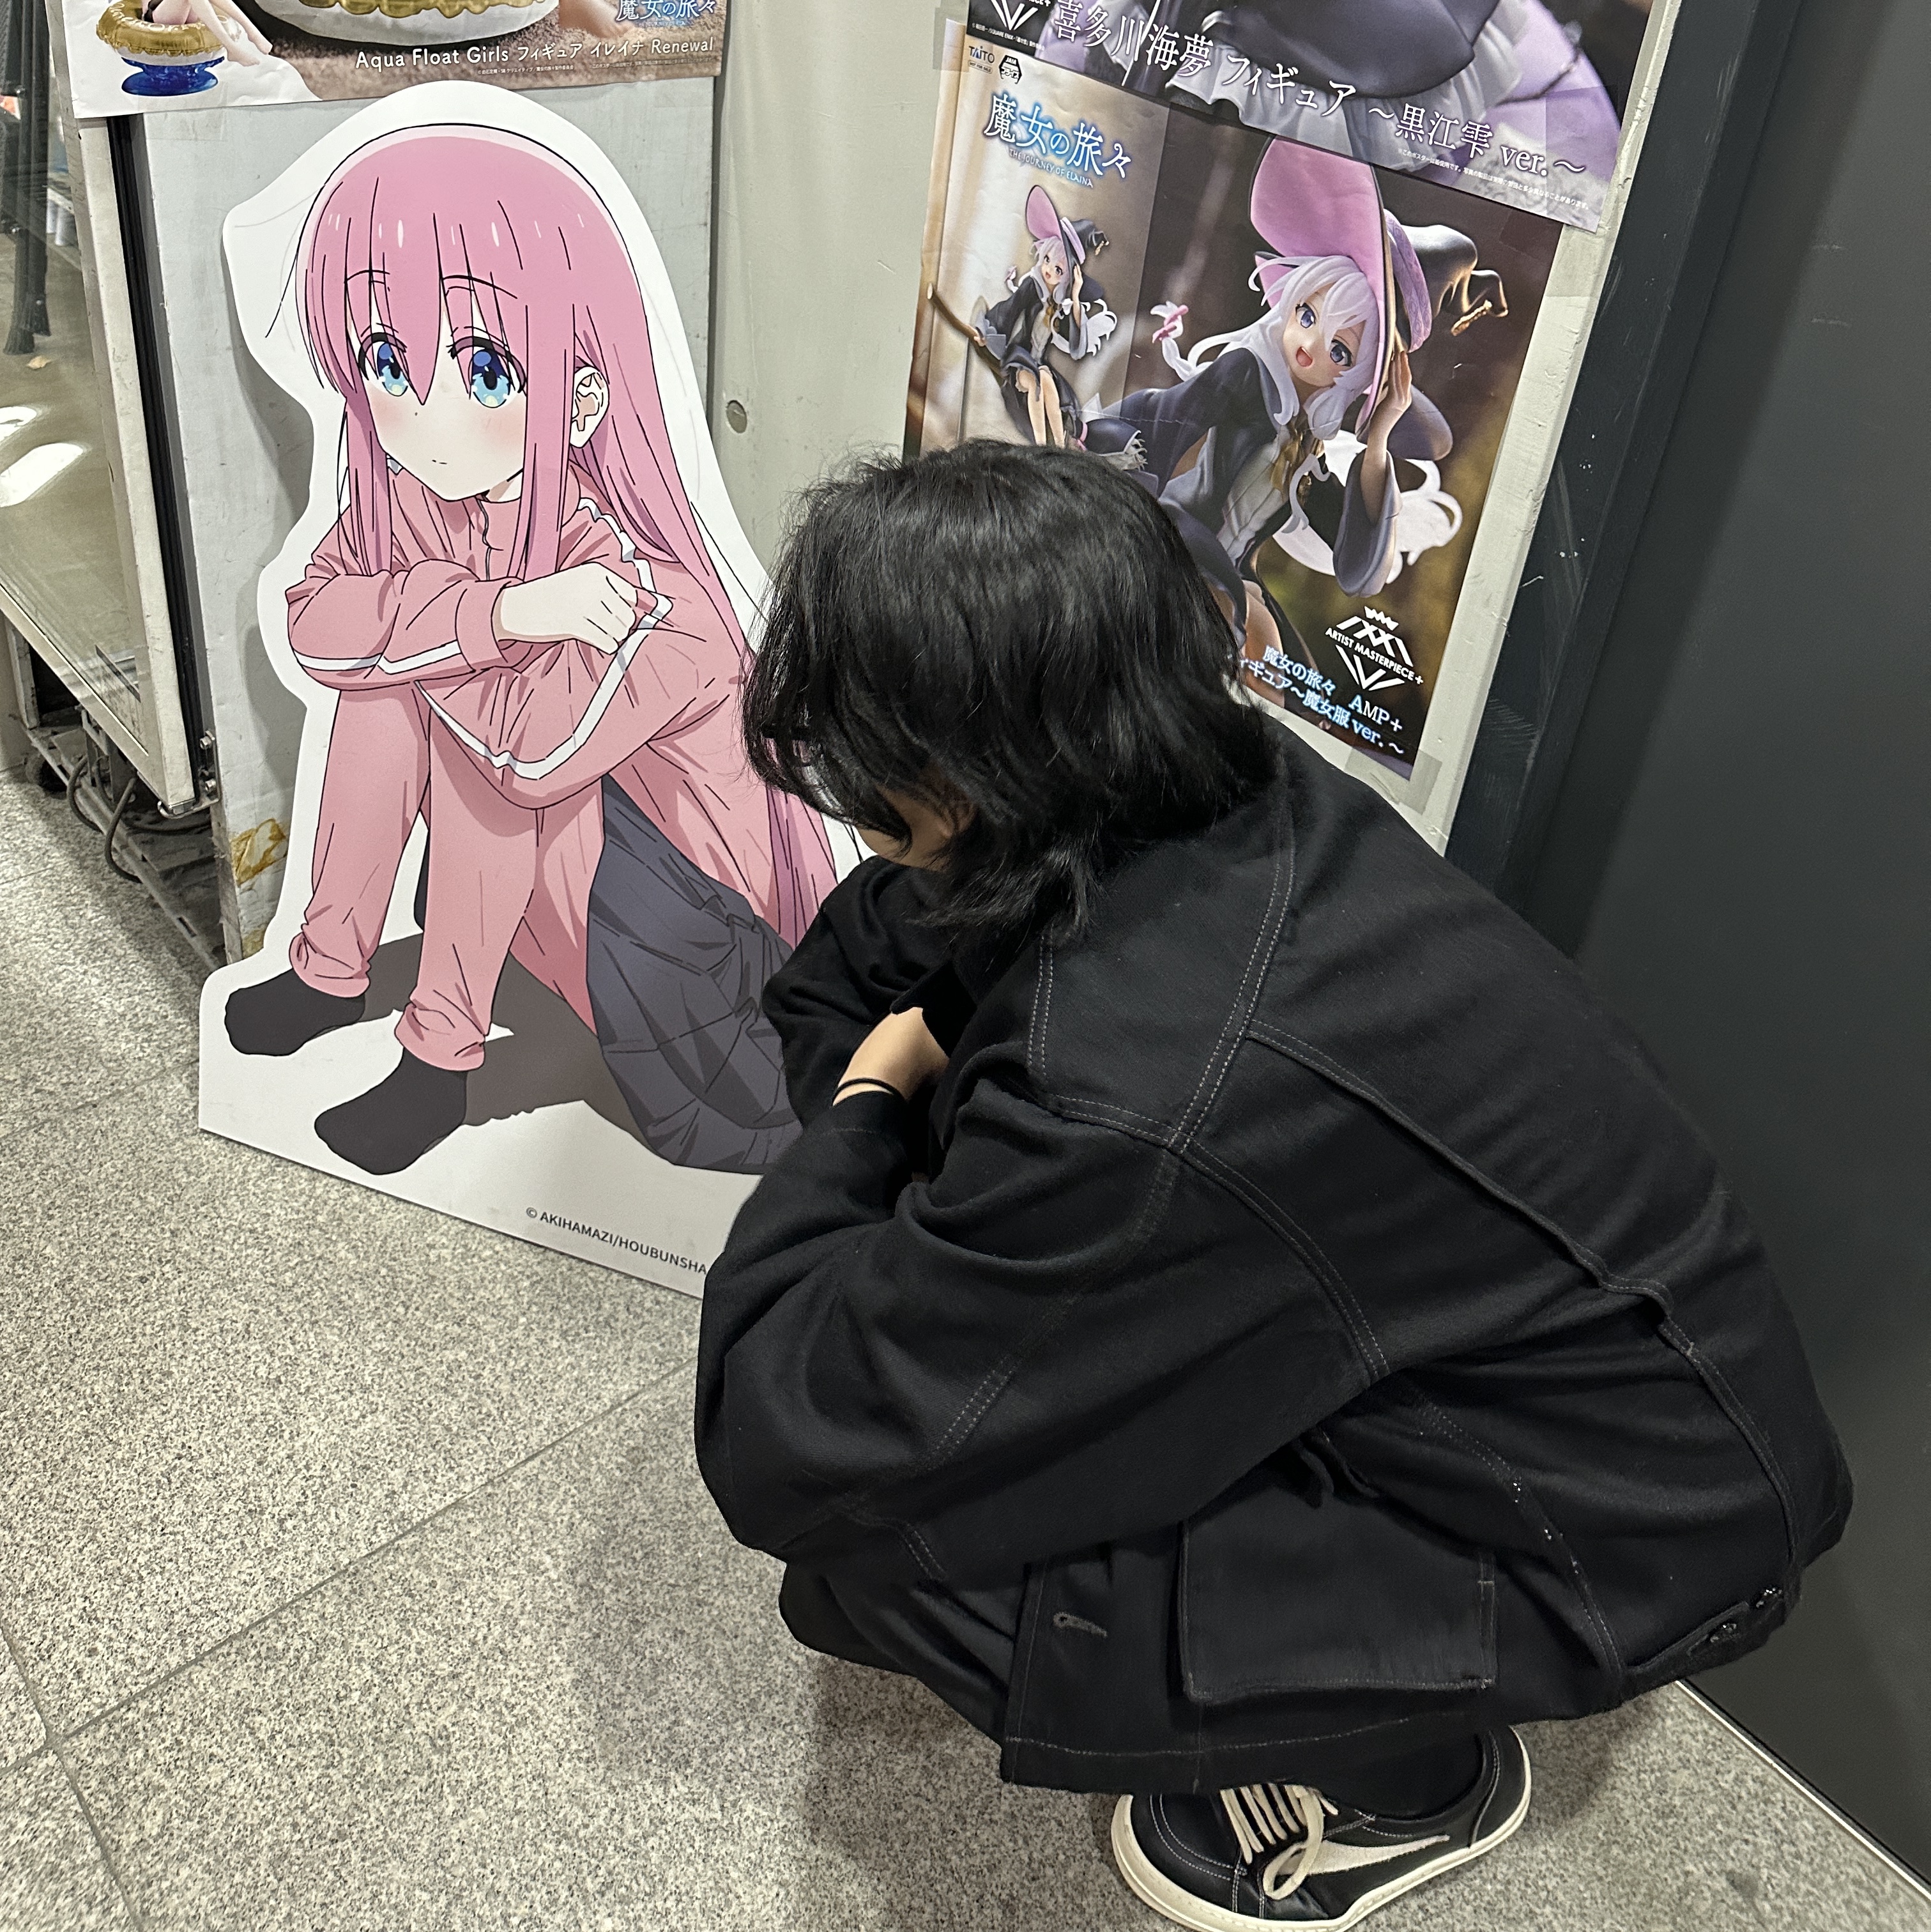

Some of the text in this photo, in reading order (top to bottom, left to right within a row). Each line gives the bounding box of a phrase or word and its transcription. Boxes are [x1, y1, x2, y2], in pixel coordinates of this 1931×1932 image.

[356, 37, 714, 73] Aqua Float Girls フィギュア イレイナ Renewal
[984, 94, 1131, 178] 魔女の旅々
[1009, 149, 1094, 188] THE JOURNEY OF ELAINA
[1325, 627, 1354, 648] ARTIST
[1262, 645, 1336, 696] 魔女の旅々
[540, 1211, 707, 1275] AKIHAMAZI/HOUBUNSHA
